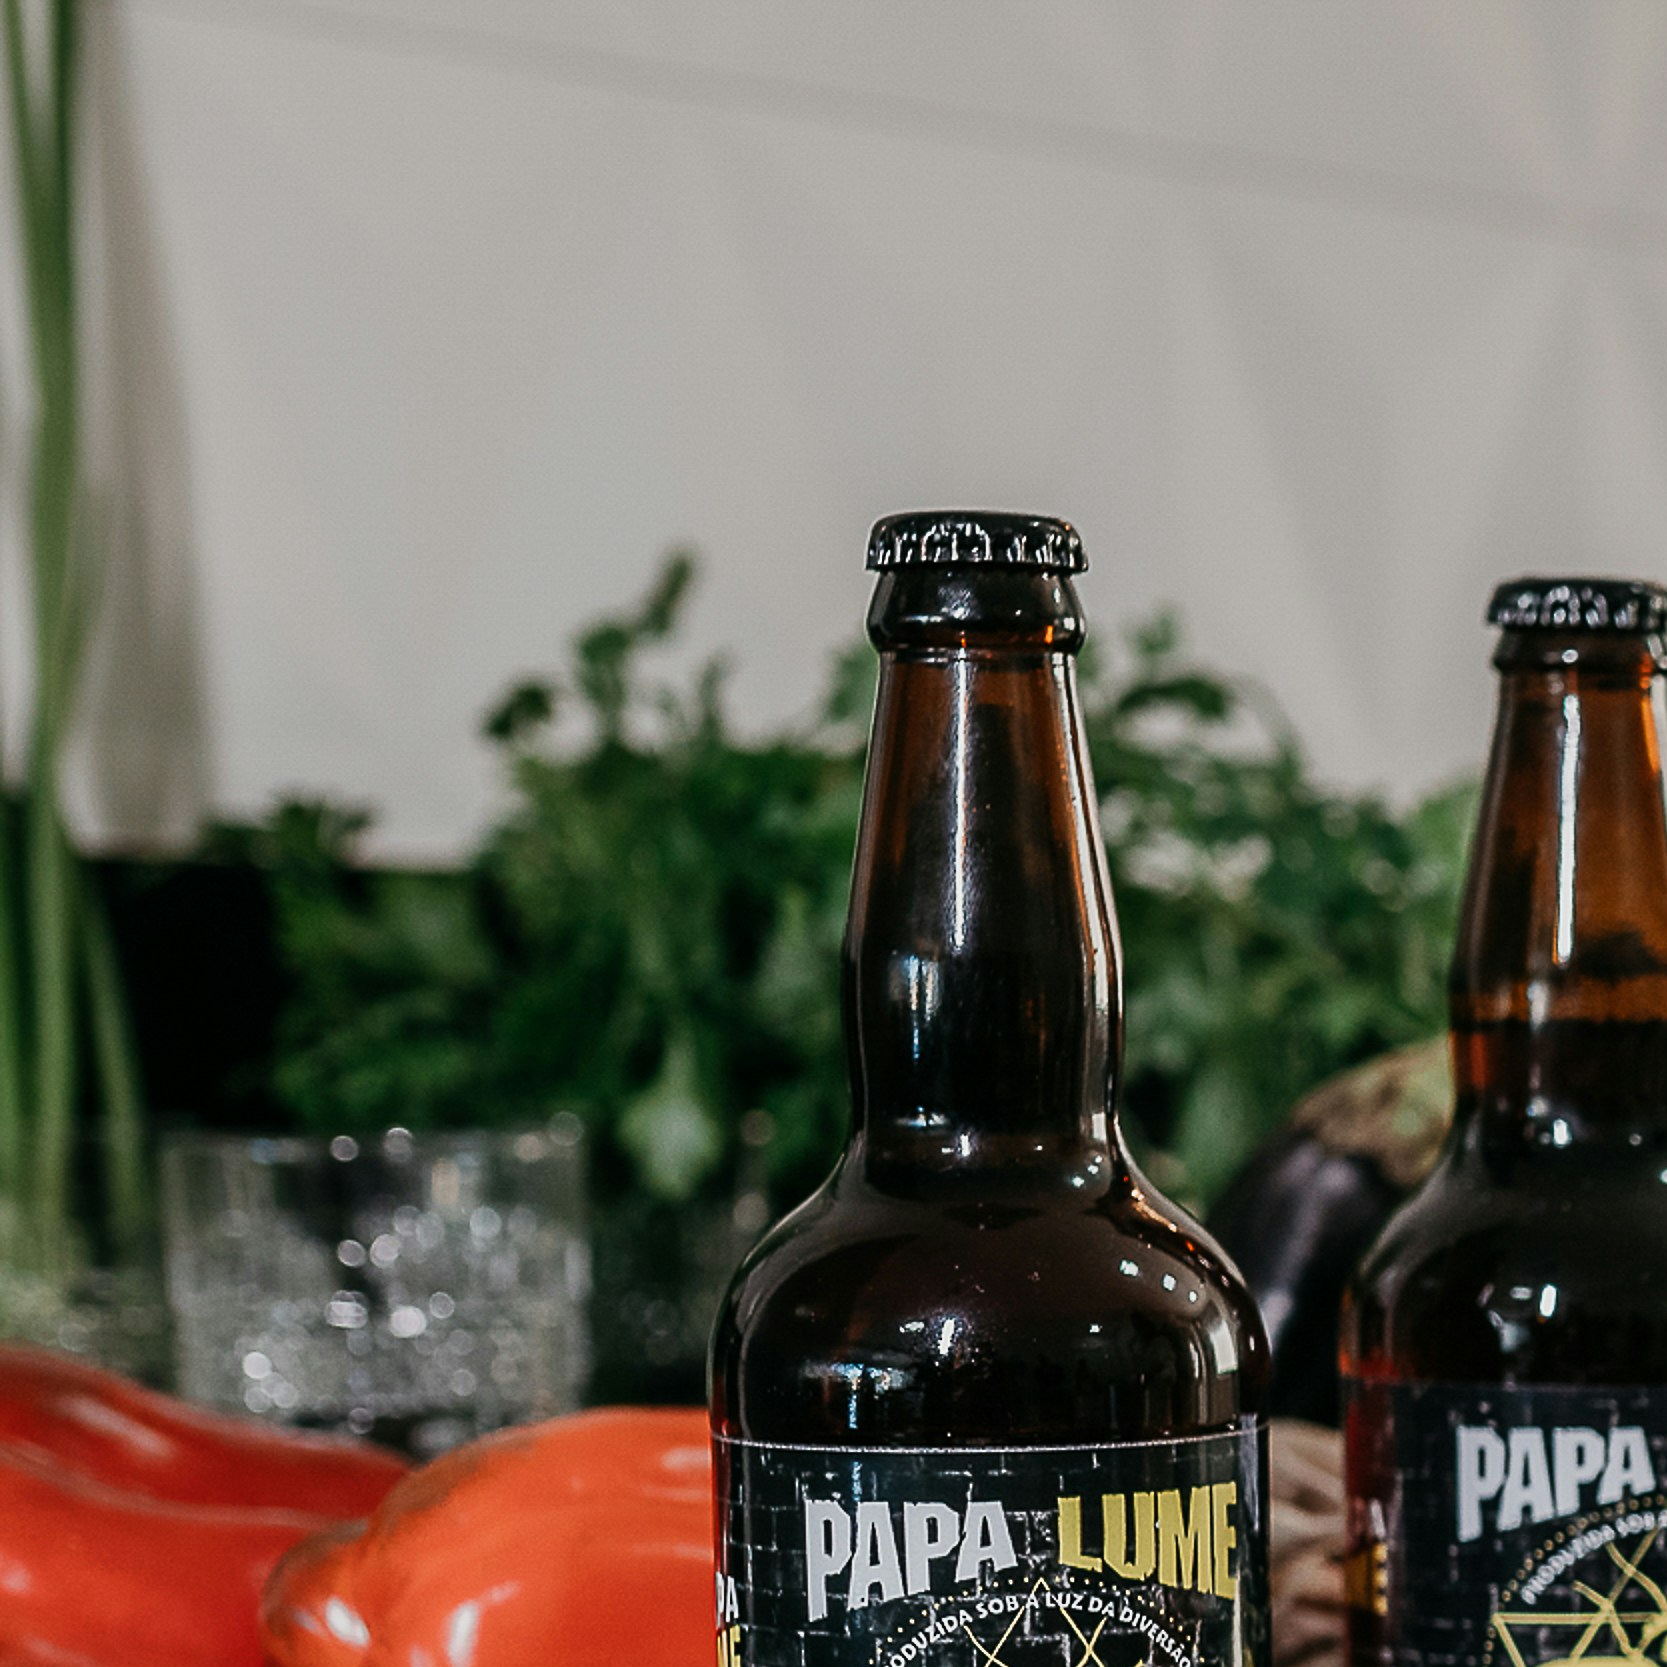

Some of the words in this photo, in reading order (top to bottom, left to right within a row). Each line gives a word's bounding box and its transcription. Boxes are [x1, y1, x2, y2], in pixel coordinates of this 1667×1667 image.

[1455, 1425, 1656, 1543] PAPA
[804, 1498, 1018, 1623] PAPA
[1057, 1481, 1238, 1600] LUME
[715, 1570, 739, 1630] PA
[975, 1596, 1019, 1619] SOB
[1024, 1594, 1040, 1610] A
[1045, 1592, 1084, 1612] LUZ
[1087, 1597, 1116, 1618] DA
